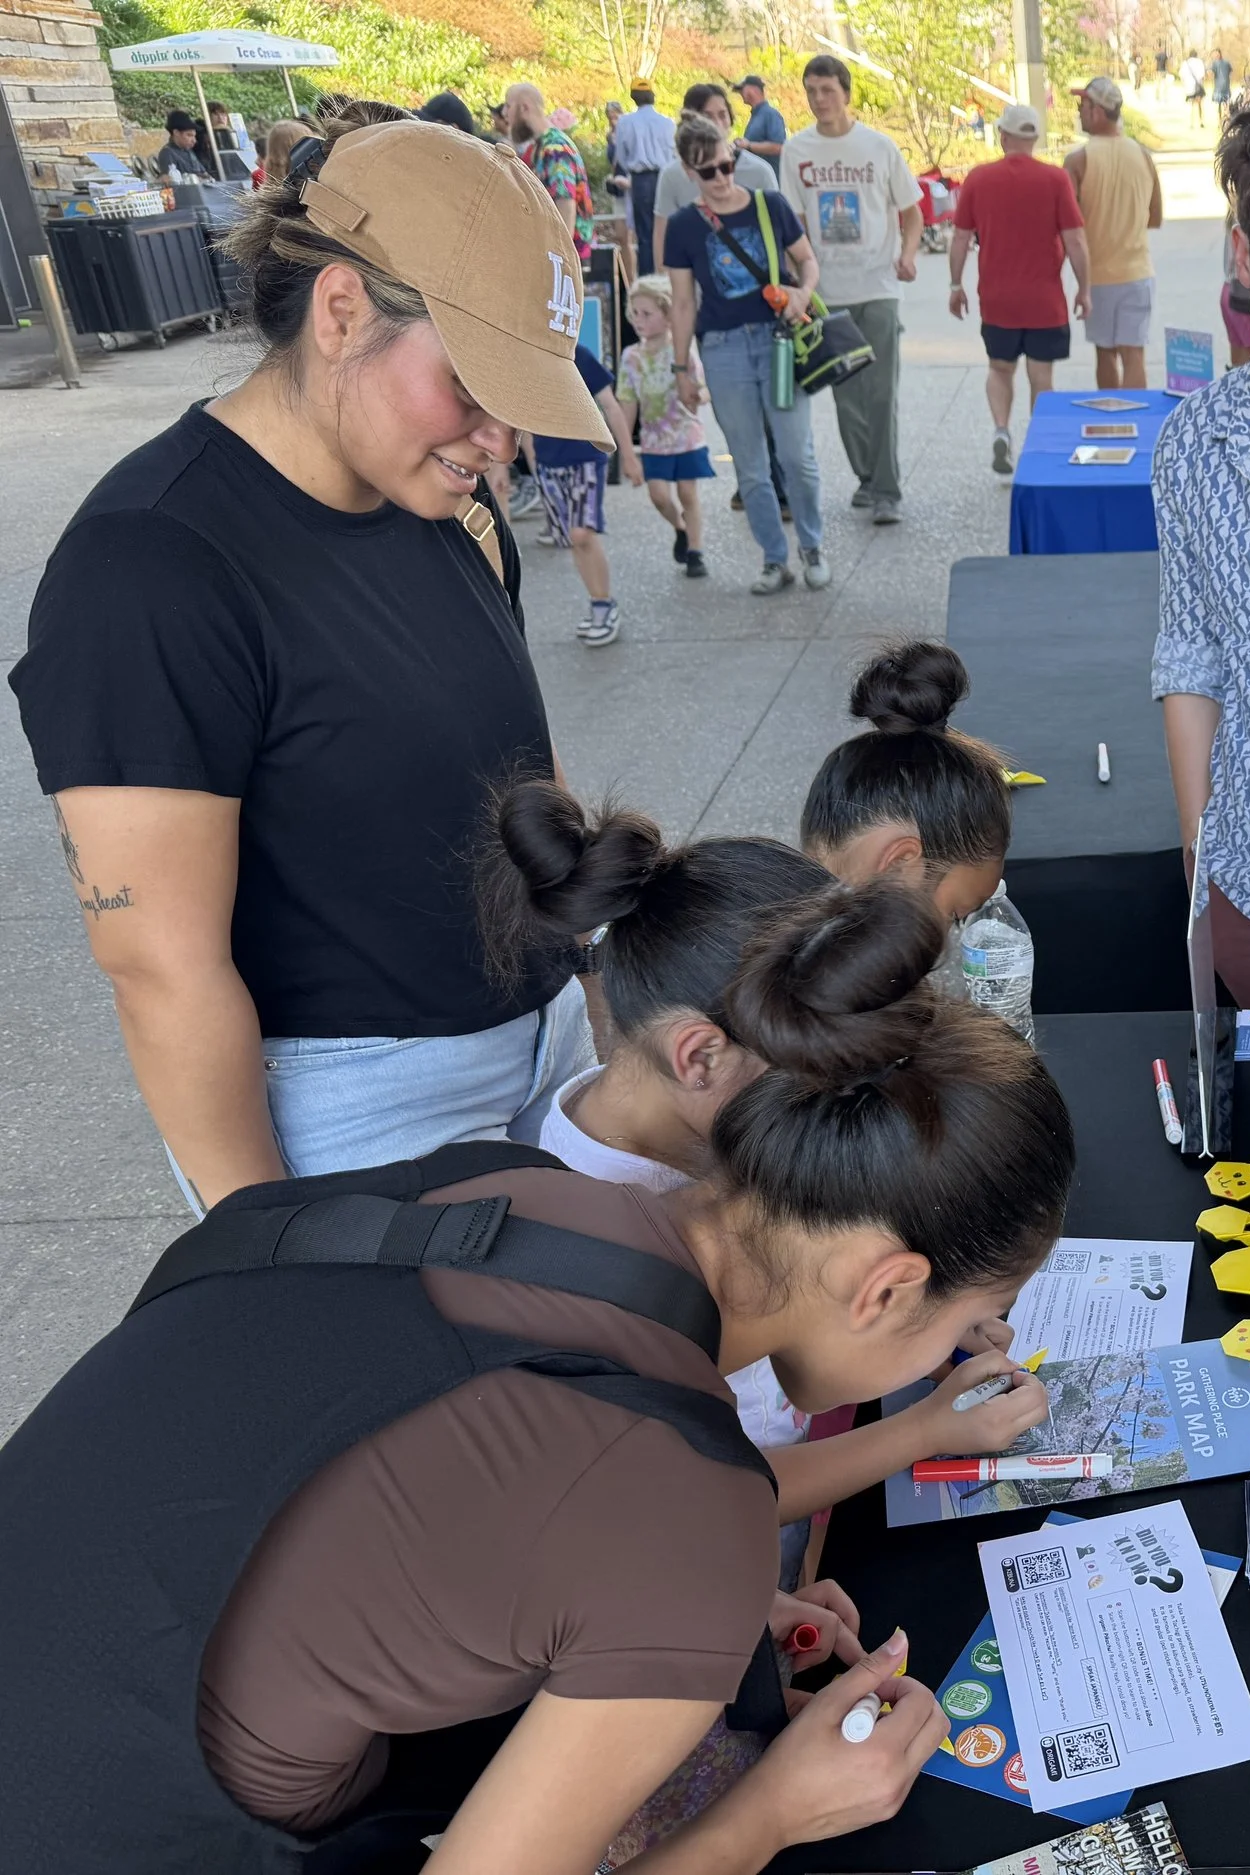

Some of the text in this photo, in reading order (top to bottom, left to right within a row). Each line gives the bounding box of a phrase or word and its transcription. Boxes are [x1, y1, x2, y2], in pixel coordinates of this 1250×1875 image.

[236, 46, 256, 59] Ice
[547, 251, 580, 338] LA
[93, 885, 135, 911] heart
[1130, 1256, 1145, 1283] KNOW
[1149, 1255, 1164, 1281] DID YOU
[1169, 1358, 1214, 1458] PARK MAP
[1199, 1367, 1228, 1439] GATHERING PLACE
[1114, 1536, 1150, 1575] KNOW
[1136, 1528, 1171, 1567] DID YOU
[1150, 1608, 1158, 1617] and
[1172, 1619, 1180, 1636] Tochigi
[1098, 1614, 1106, 1631] origami
[1103, 1632, 1112, 1653] Pikachu!
[1108, 1653, 1117, 1671] Really?
[1122, 1711, 1130, 1719] yo!
[1113, 1631, 1125, 1662] bottom-right
[1136, 1641, 1153, 1685] BONUS TIME!
[1175, 1637, 1188, 1661] prefecture
[1086, 1665, 1101, 1709] SPEAK JAPANESE!
[1122, 1629, 1134, 1656] bottom-left
[1140, 1695, 1148, 1708] about
[1144, 1709, 1153, 1726] kibuna
[1162, 1615, 1170, 1634] famous
[1171, 1649, 1180, 1666] kibuna
[1180, 1677, 1190, 1696] legend,
[1188, 1703, 1201, 1735] strawberries,
[1184, 1629, 1194, 1651] Japanese
[1199, 1675, 1216, 1713] UTSUNOMIYA!
[1045, 1748, 1057, 1776] ORIGAMI
[1111, 1823, 1146, 1871] NEW
[1142, 1812, 1183, 1875] HELLO
